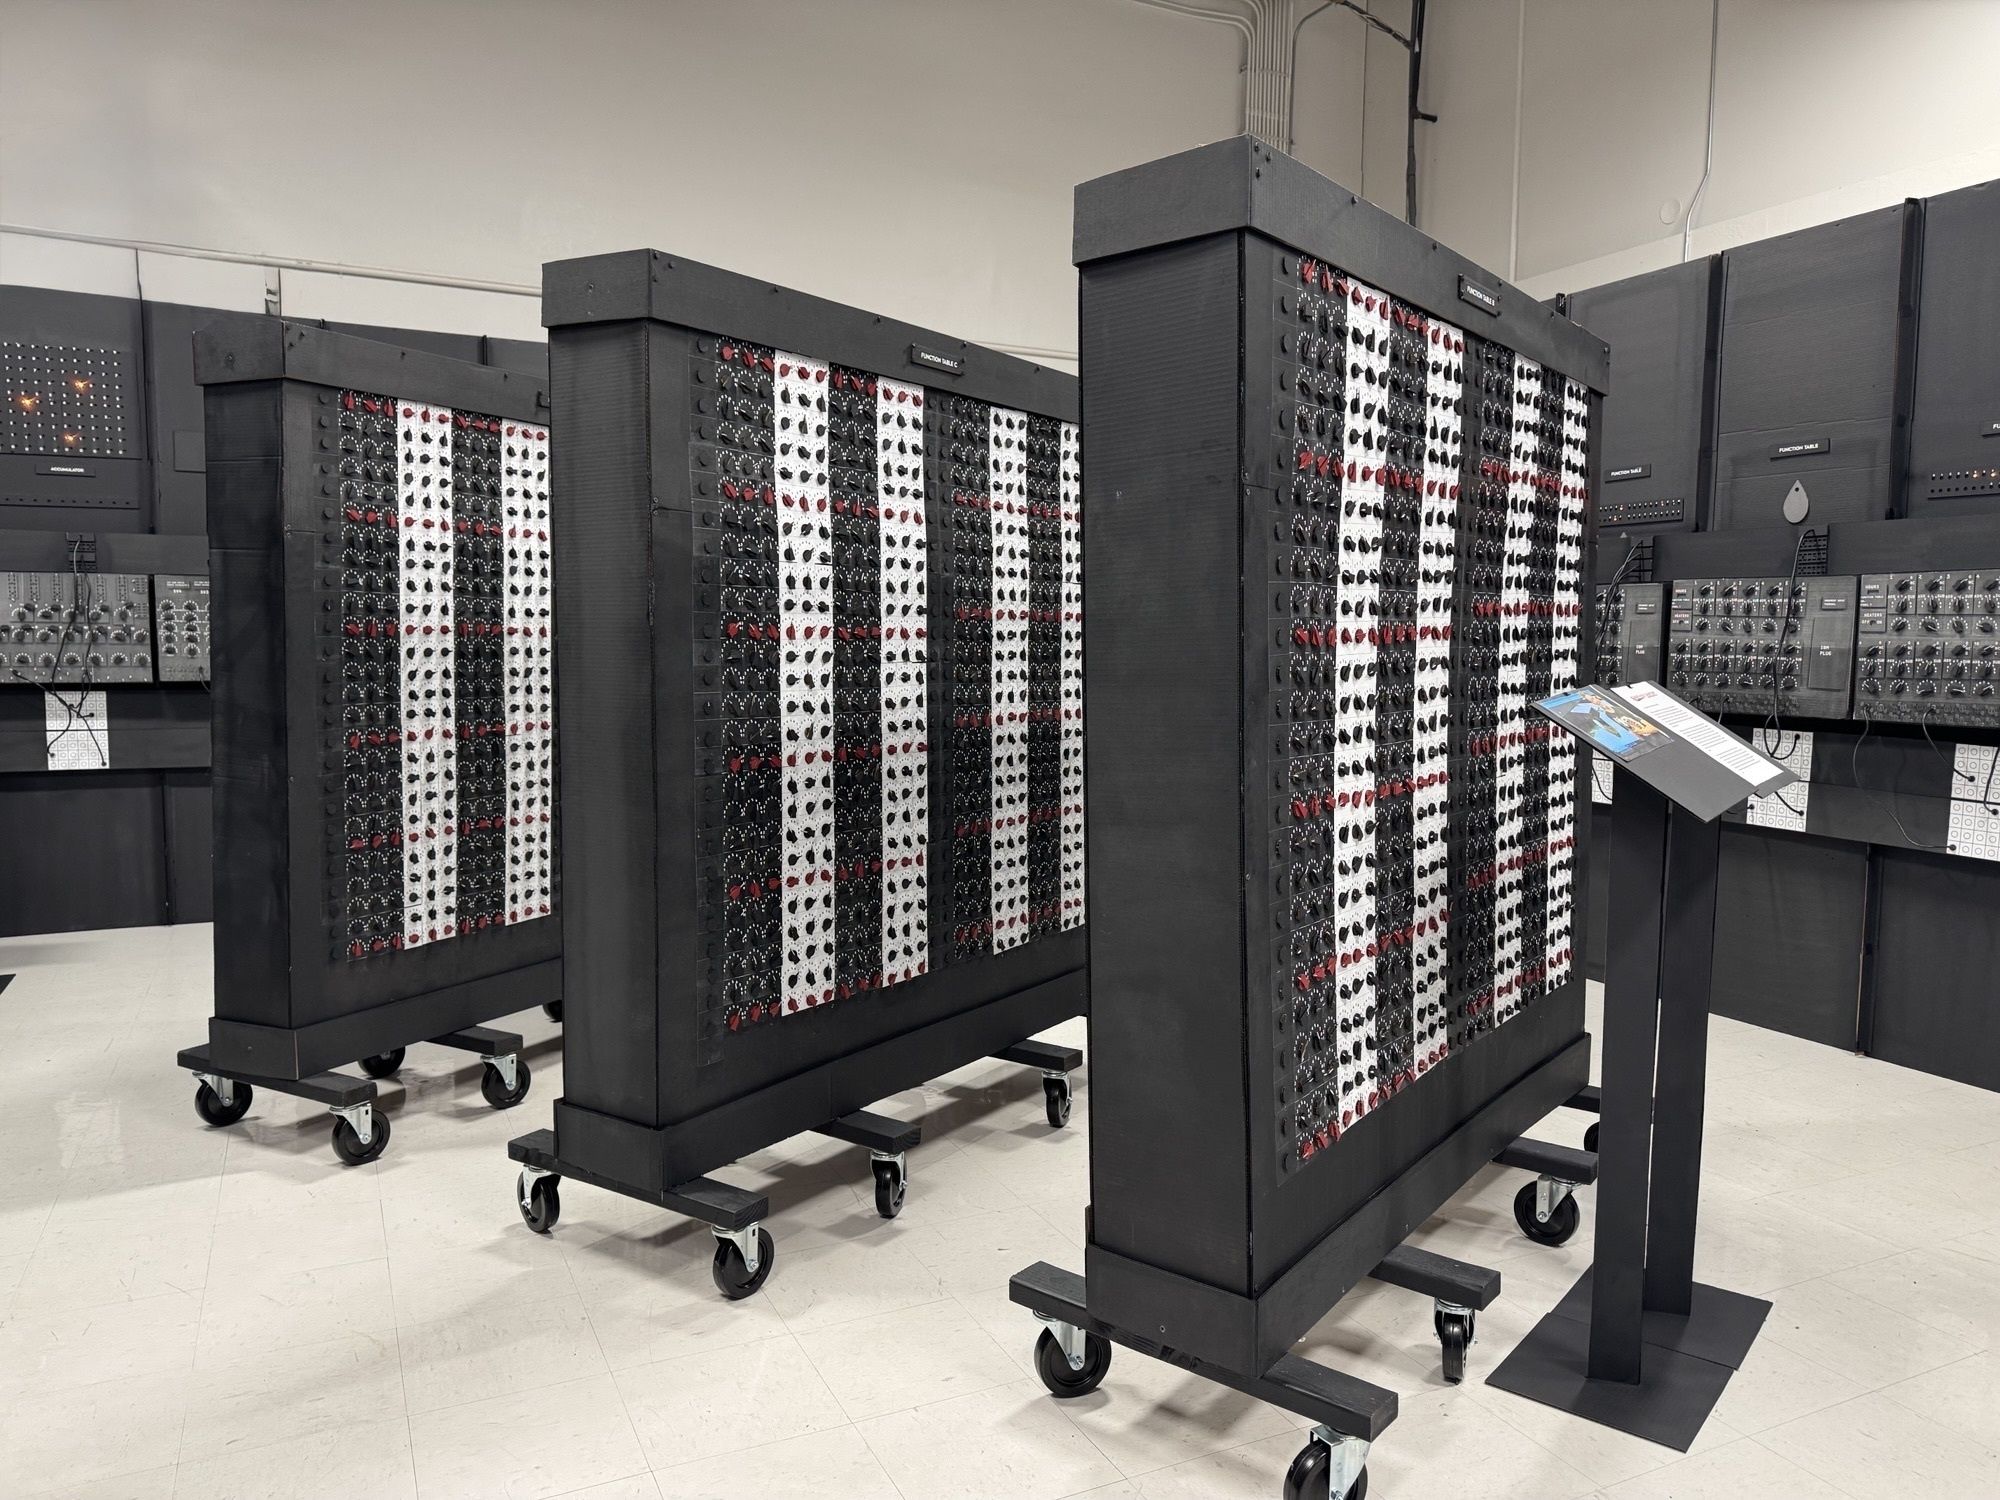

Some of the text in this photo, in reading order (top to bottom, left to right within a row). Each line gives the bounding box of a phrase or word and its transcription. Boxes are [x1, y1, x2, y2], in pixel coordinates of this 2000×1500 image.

[920, 352, 942, 363] FUNCTION
[941, 357, 953, 368] TABLE
[1778, 442, 1819, 453] FUNCTION TABLE
[1630, 466, 1642, 474] TABLE
